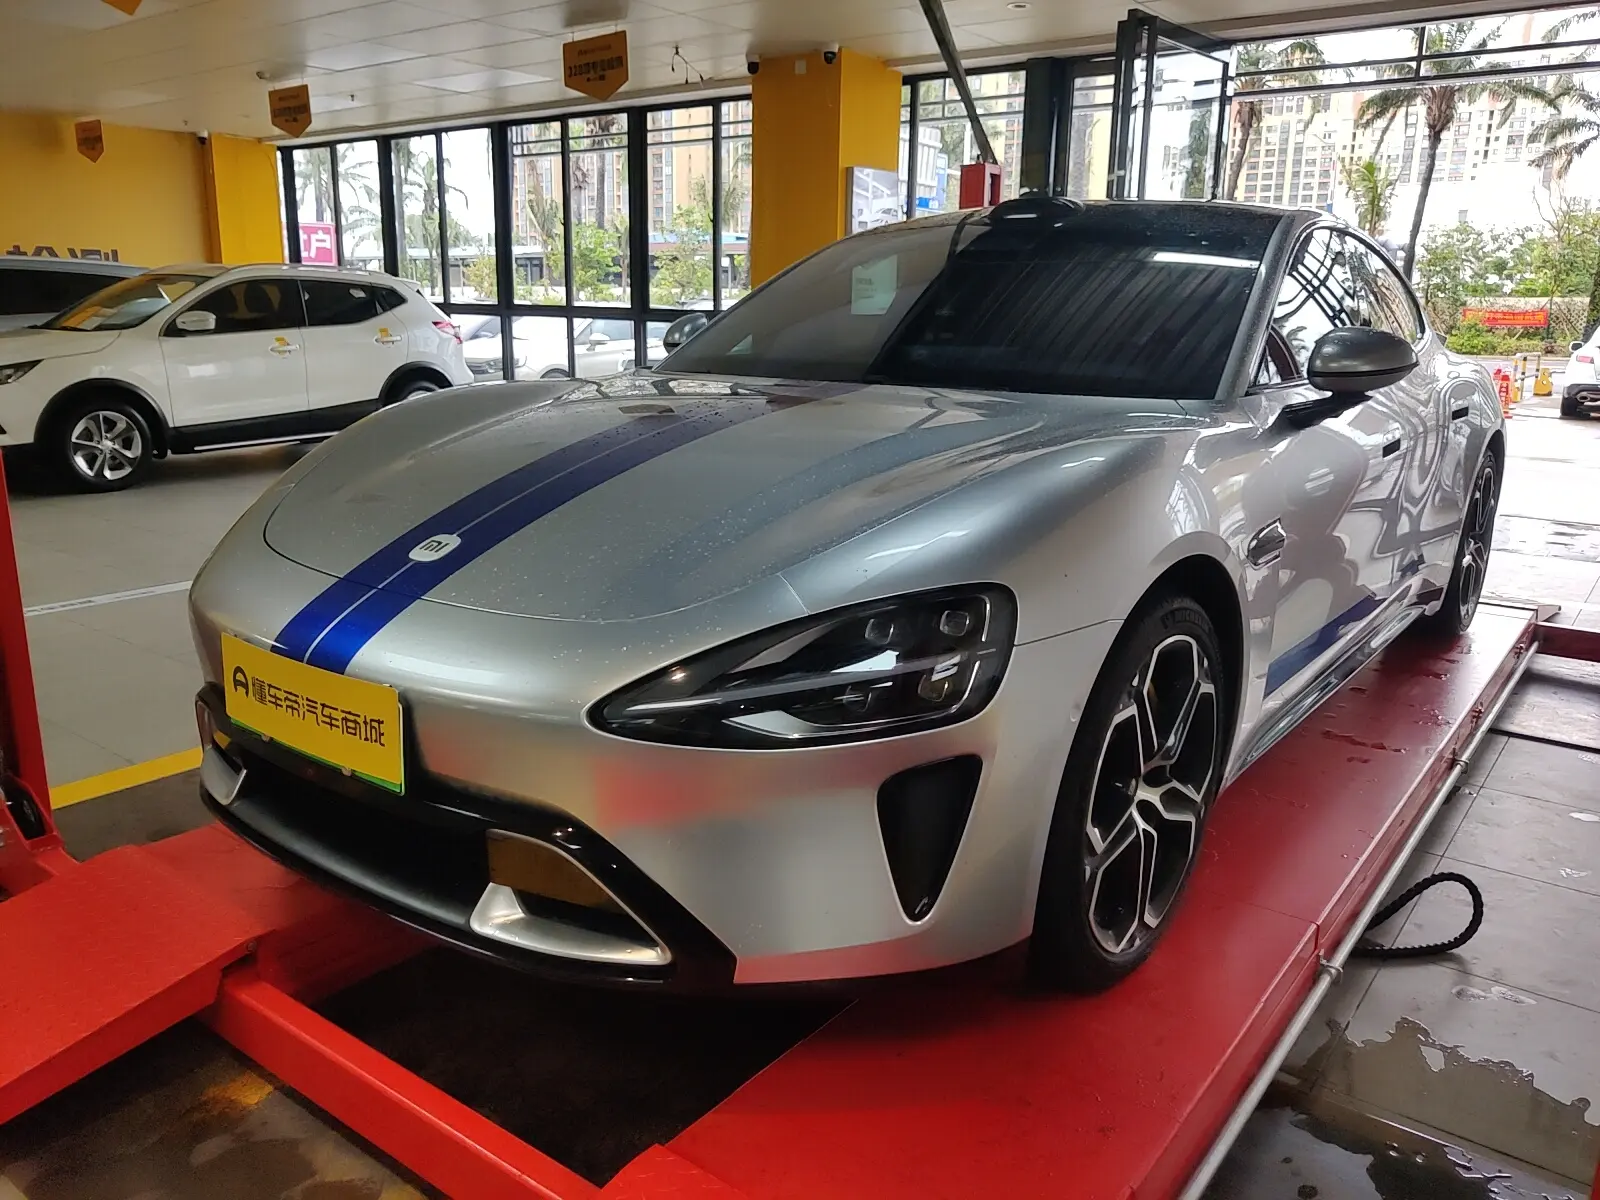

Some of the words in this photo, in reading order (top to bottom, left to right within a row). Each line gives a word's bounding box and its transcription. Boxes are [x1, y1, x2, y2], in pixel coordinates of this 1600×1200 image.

[251, 676, 386, 748] 懂车帝汽车商城
